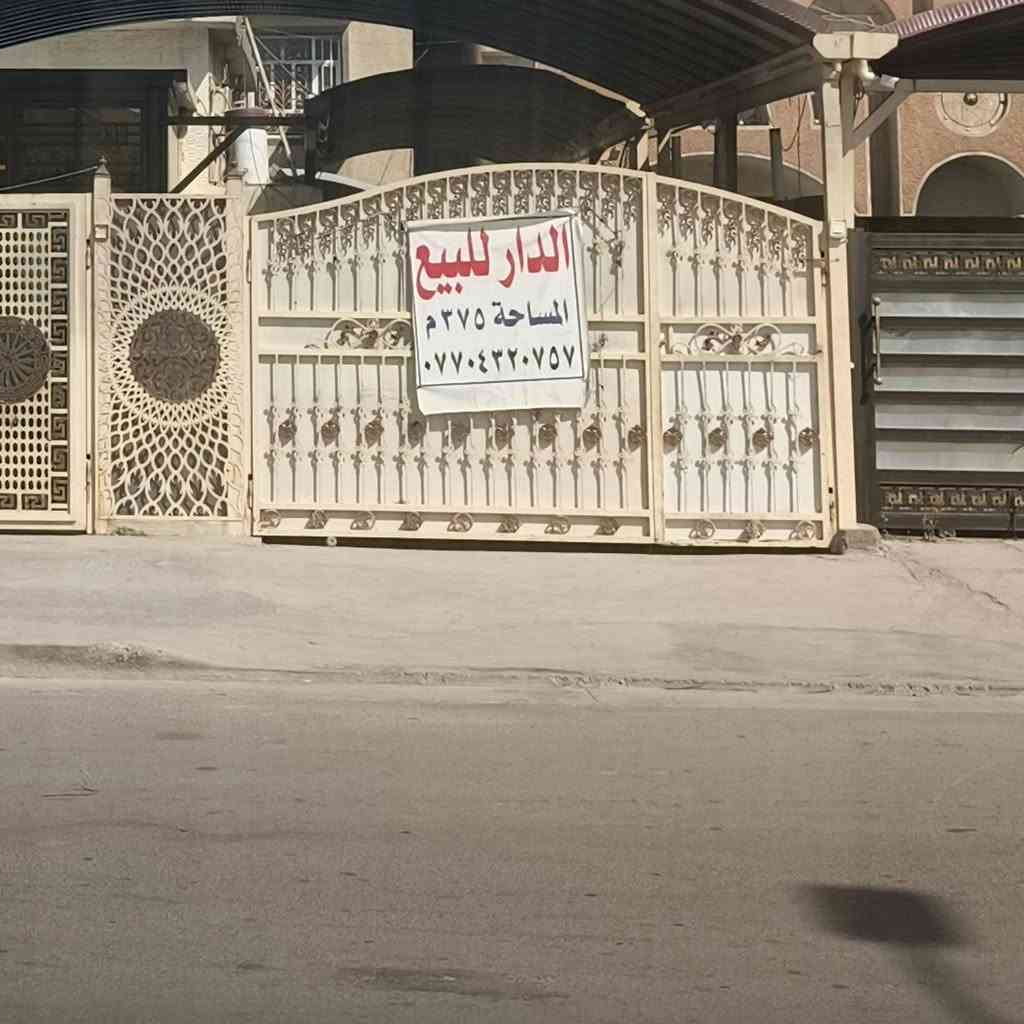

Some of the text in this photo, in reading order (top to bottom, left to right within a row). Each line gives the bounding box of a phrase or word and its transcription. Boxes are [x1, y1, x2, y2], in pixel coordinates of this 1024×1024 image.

[416, 223, 570, 300] الدار للبيع
[492, 299, 568, 327] المساحة
[424, 345, 575, 374] ٠٧٧٠٤٣٢٠٧٥٧
